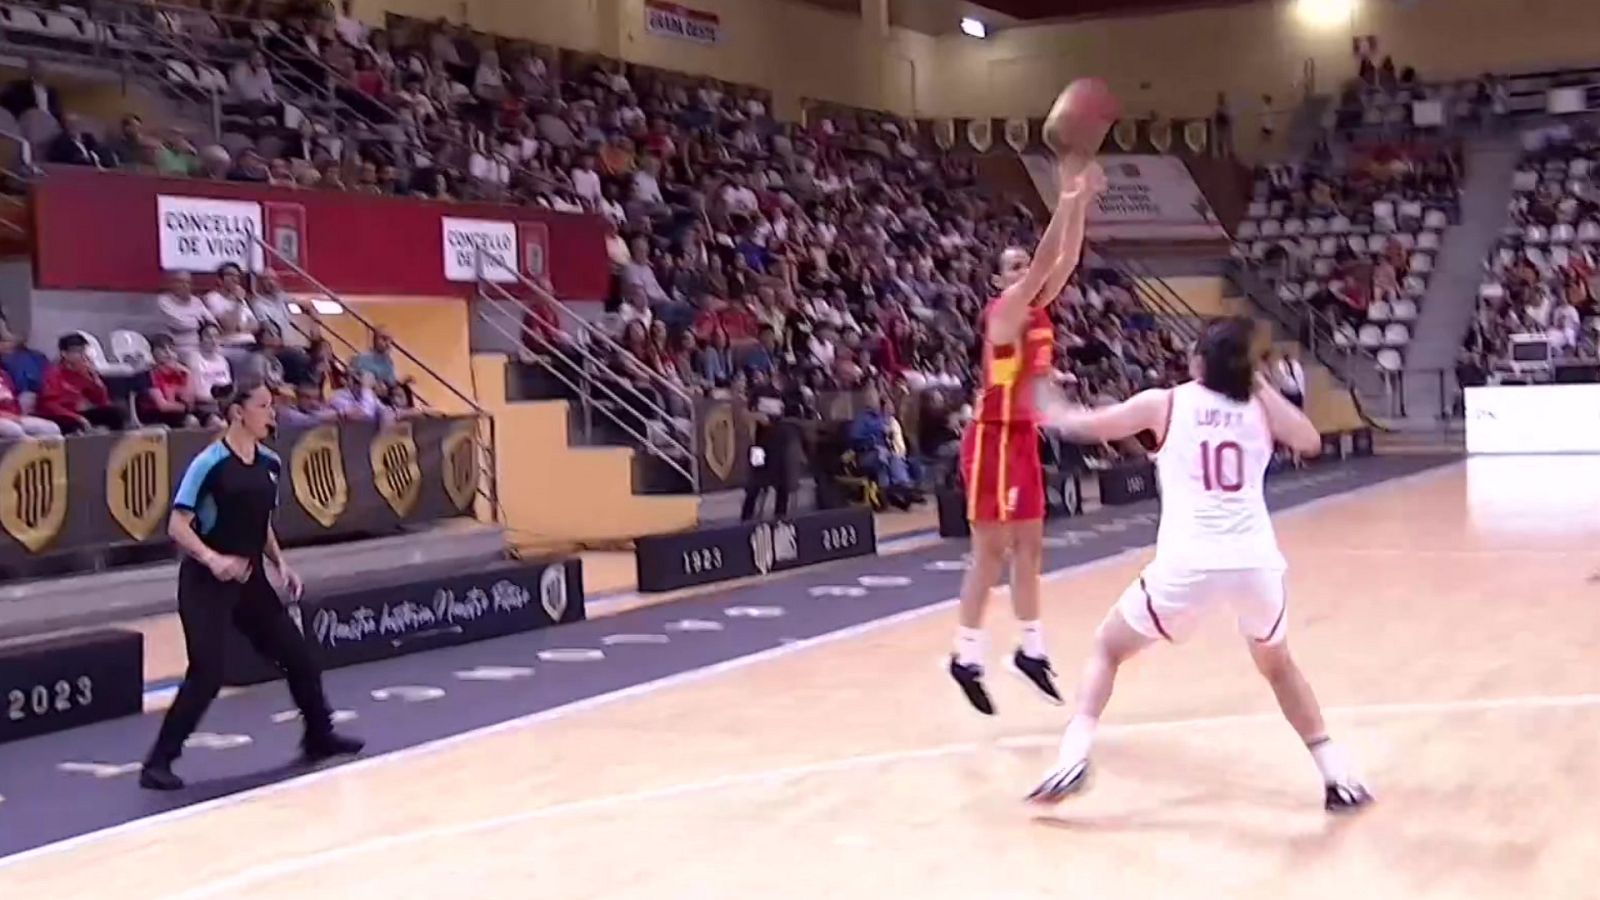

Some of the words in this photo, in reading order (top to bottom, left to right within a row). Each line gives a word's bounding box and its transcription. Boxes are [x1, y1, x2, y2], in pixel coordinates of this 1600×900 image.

[165, 210, 255, 236] CONCELLO
[177, 235, 200, 256] DE
[205, 236, 247, 257] VIGO
[447, 229, 512, 251] CONCELLO
[1200, 440, 1244, 493] 10
[8, 674, 93, 721] 2023
